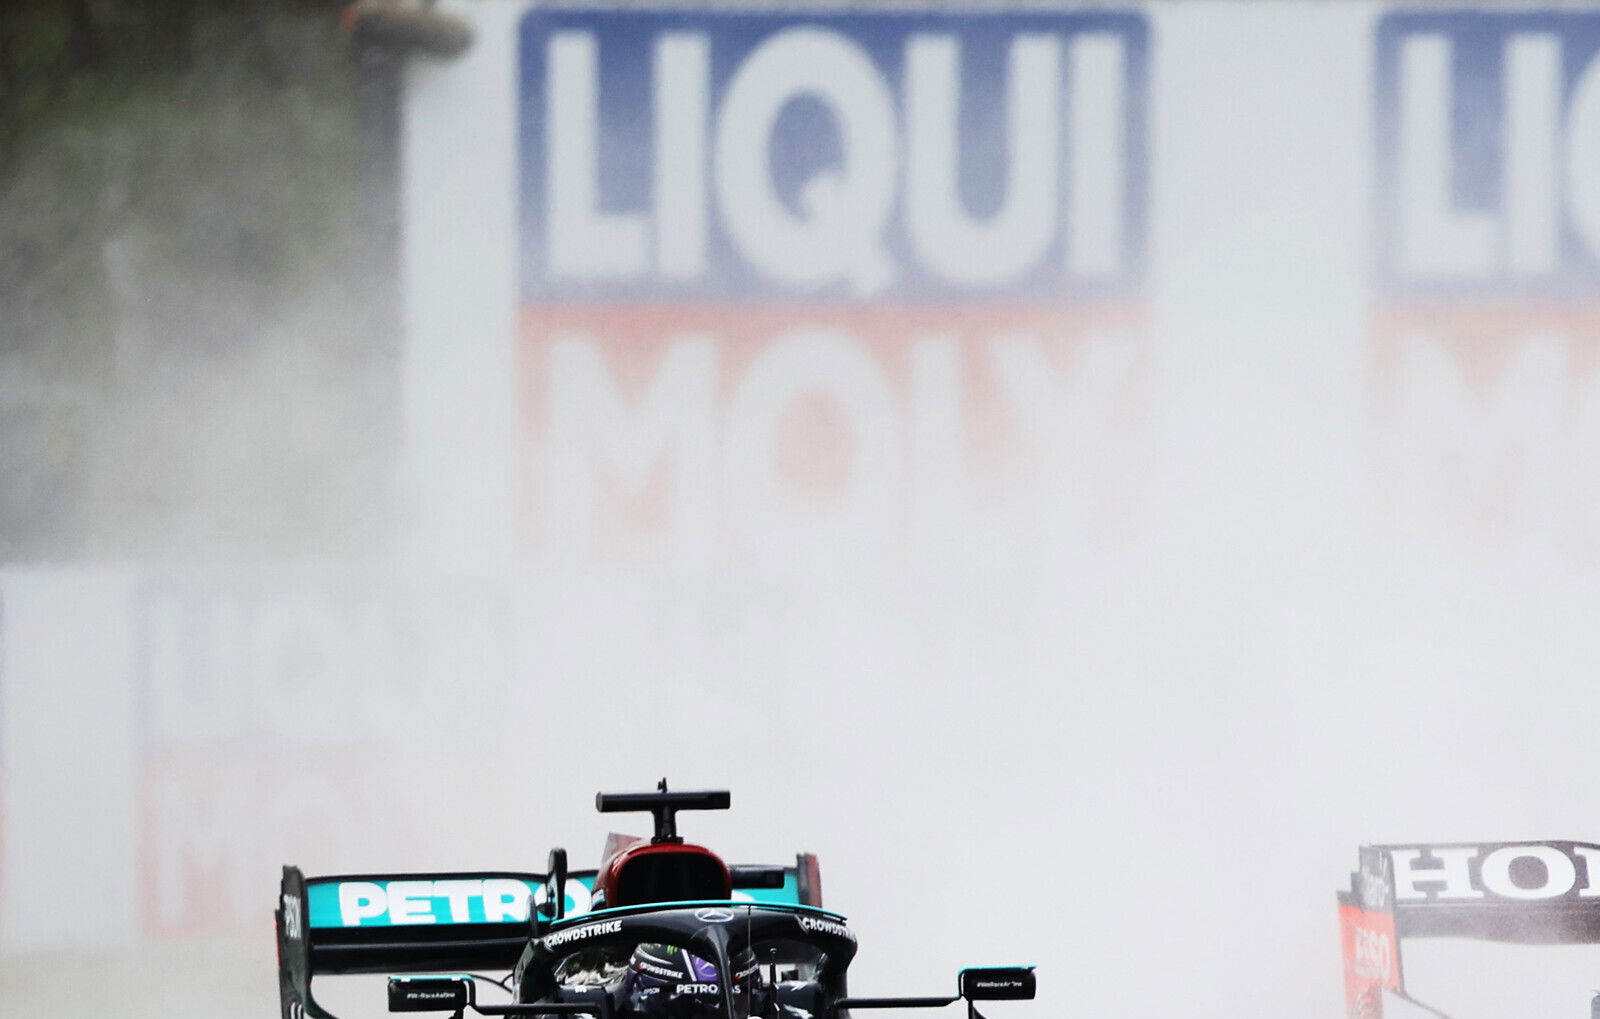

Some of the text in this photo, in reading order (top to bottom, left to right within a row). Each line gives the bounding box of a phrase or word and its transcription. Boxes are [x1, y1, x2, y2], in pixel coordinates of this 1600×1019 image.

[548, 25, 1125, 296] LIQUI
[548, 326, 1140, 565] MOLY
[339, 879, 593, 926] PETRO
[548, 921, 622, 948] CROWDSTRIKE
[676, 983, 741, 994] PETROS
